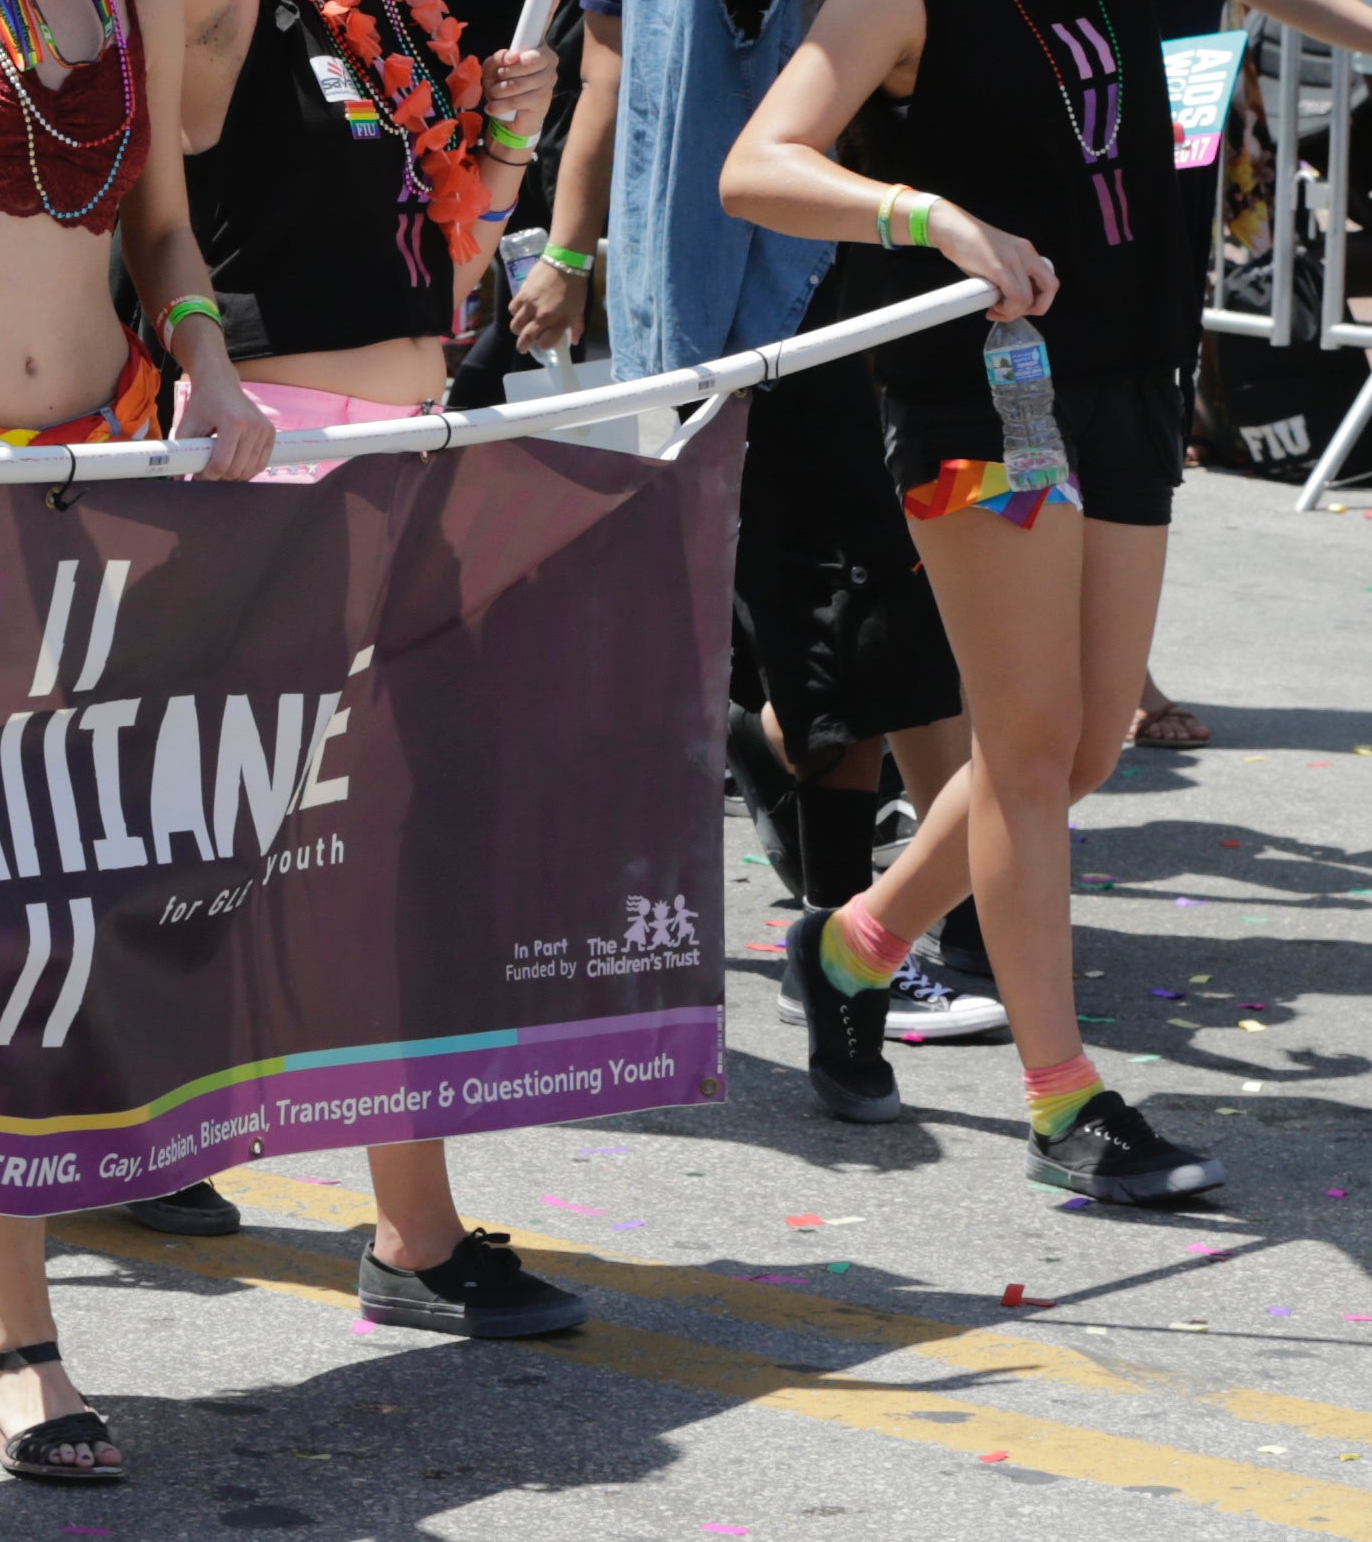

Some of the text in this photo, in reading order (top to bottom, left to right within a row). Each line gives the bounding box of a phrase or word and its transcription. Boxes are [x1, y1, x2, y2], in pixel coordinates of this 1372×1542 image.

[1177, 48, 1233, 129] AIDS
[355, 122, 376, 137] FIU
[1239, 414, 1311, 463] FIU
[159, 895, 203, 926] for
[263, 832, 345, 887] youth
[513, 939, 569, 959] In Part
[587, 937, 618, 956] The
[662, 948, 700, 968] Trust
[505, 959, 577, 983] Funded by
[98, 1152, 142, 1183] Gay,
[147, 1132, 199, 1173] Lesbian,
[200, 1104, 272, 1148] Bisexual,
[275, 1085, 430, 1129] Transgender
[437, 1080, 457, 1109] &
[461, 1064, 604, 1105] Questioning
[609, 1052, 676, 1086] Youth
